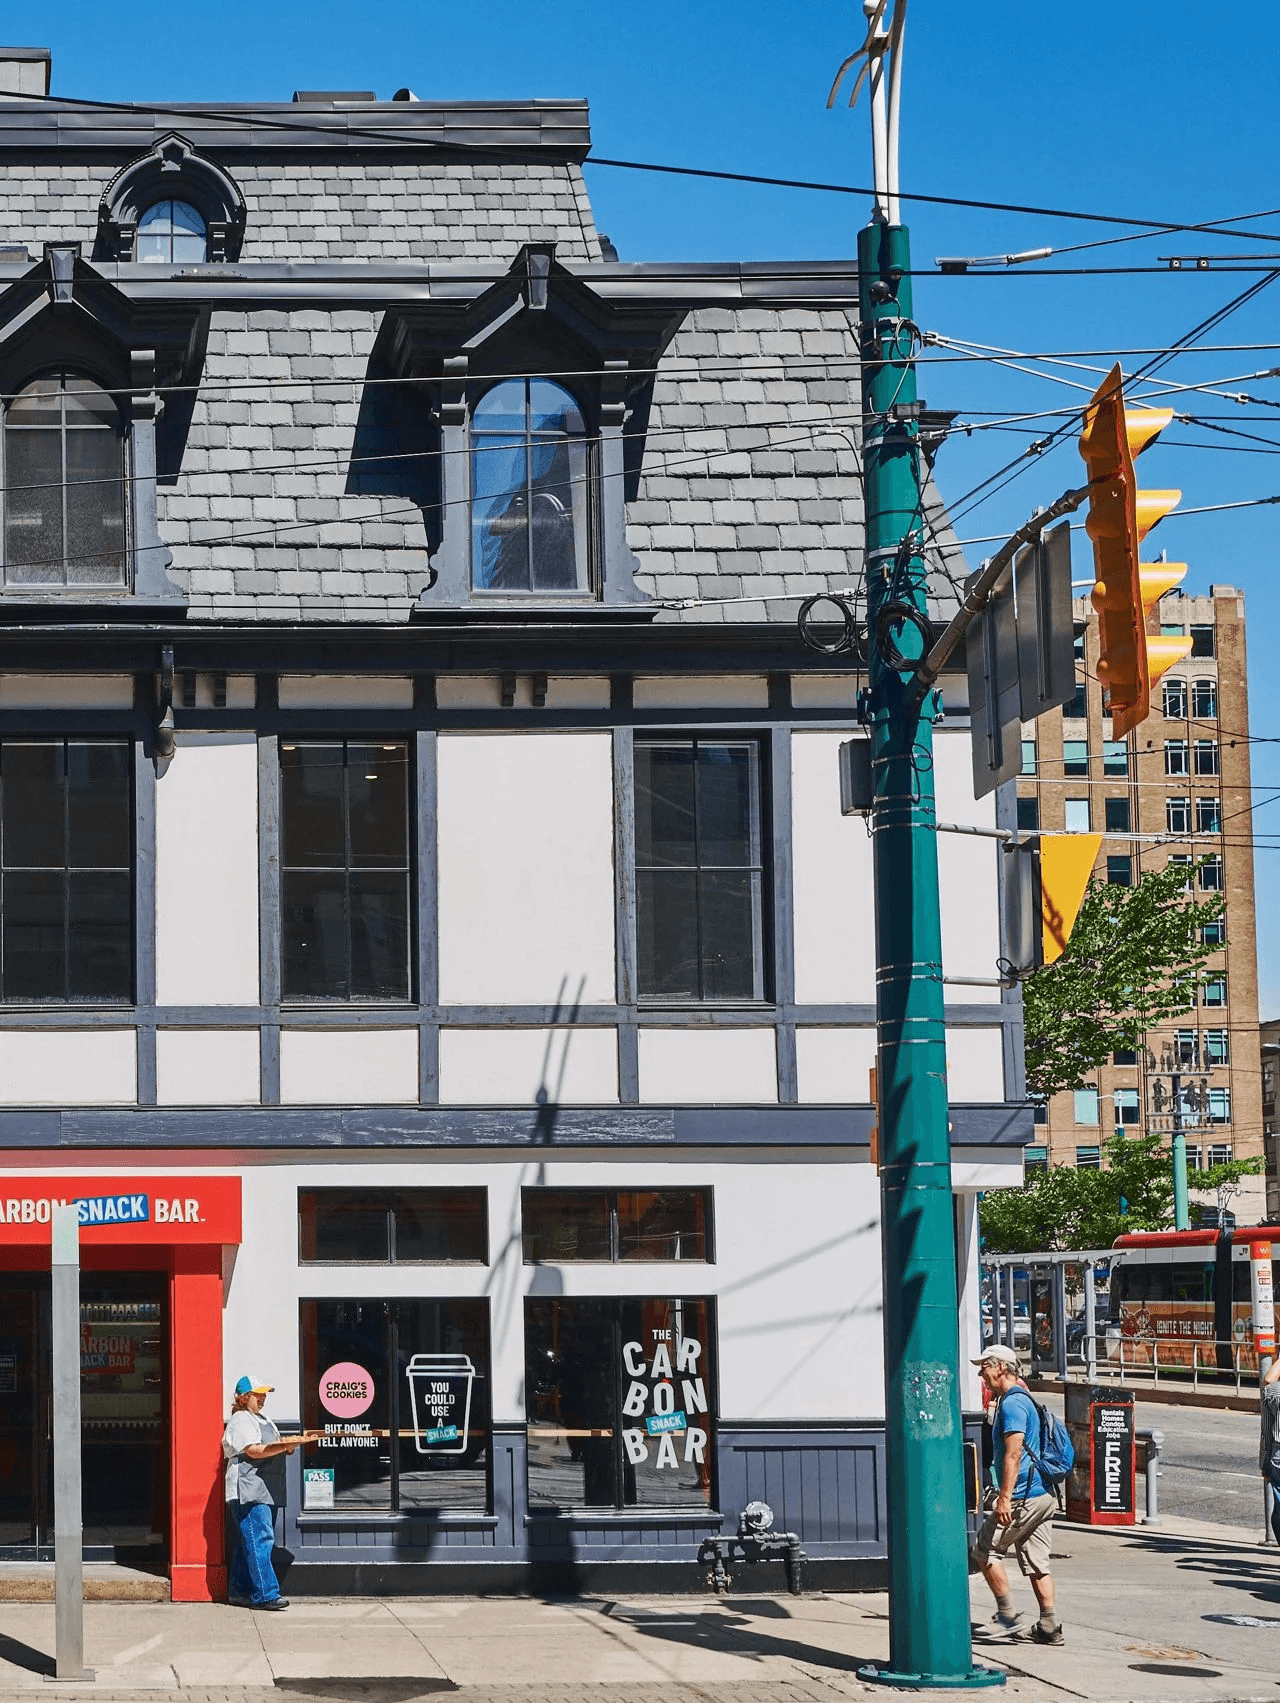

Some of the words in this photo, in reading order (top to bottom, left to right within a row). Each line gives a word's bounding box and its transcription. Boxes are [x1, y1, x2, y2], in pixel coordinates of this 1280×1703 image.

[76, 1195, 146, 1223] SNACK
[1156, 1320, 1177, 1334] IGNITE
[1179, 1320, 1192, 1335] THE
[1193, 1321, 1214, 1336] NIGHT
[651, 1329, 672, 1340] THE
[80, 1336, 131, 1353] ARBON
[622, 1336, 702, 1379] CAR
[326, 1381, 367, 1391] CRAIG'S
[431, 1382, 449, 1393] YOU
[424, 1394, 455, 1405] COULD
[622, 1377, 708, 1417] BON
[431, 1406, 449, 1417] USE
[324, 1423, 342, 1434] BUT
[344, 1423, 371, 1434] DON'T
[437, 1418, 444, 1428] A
[650, 1414, 683, 1431] SNACK
[428, 1427, 456, 1441] SNACK
[340, 1436, 379, 1447] ANYONE!
[622, 1426, 708, 1469] BAR
[308, 1472, 330, 1482] PASS
[1104, 1441, 1121, 1503] FREE
